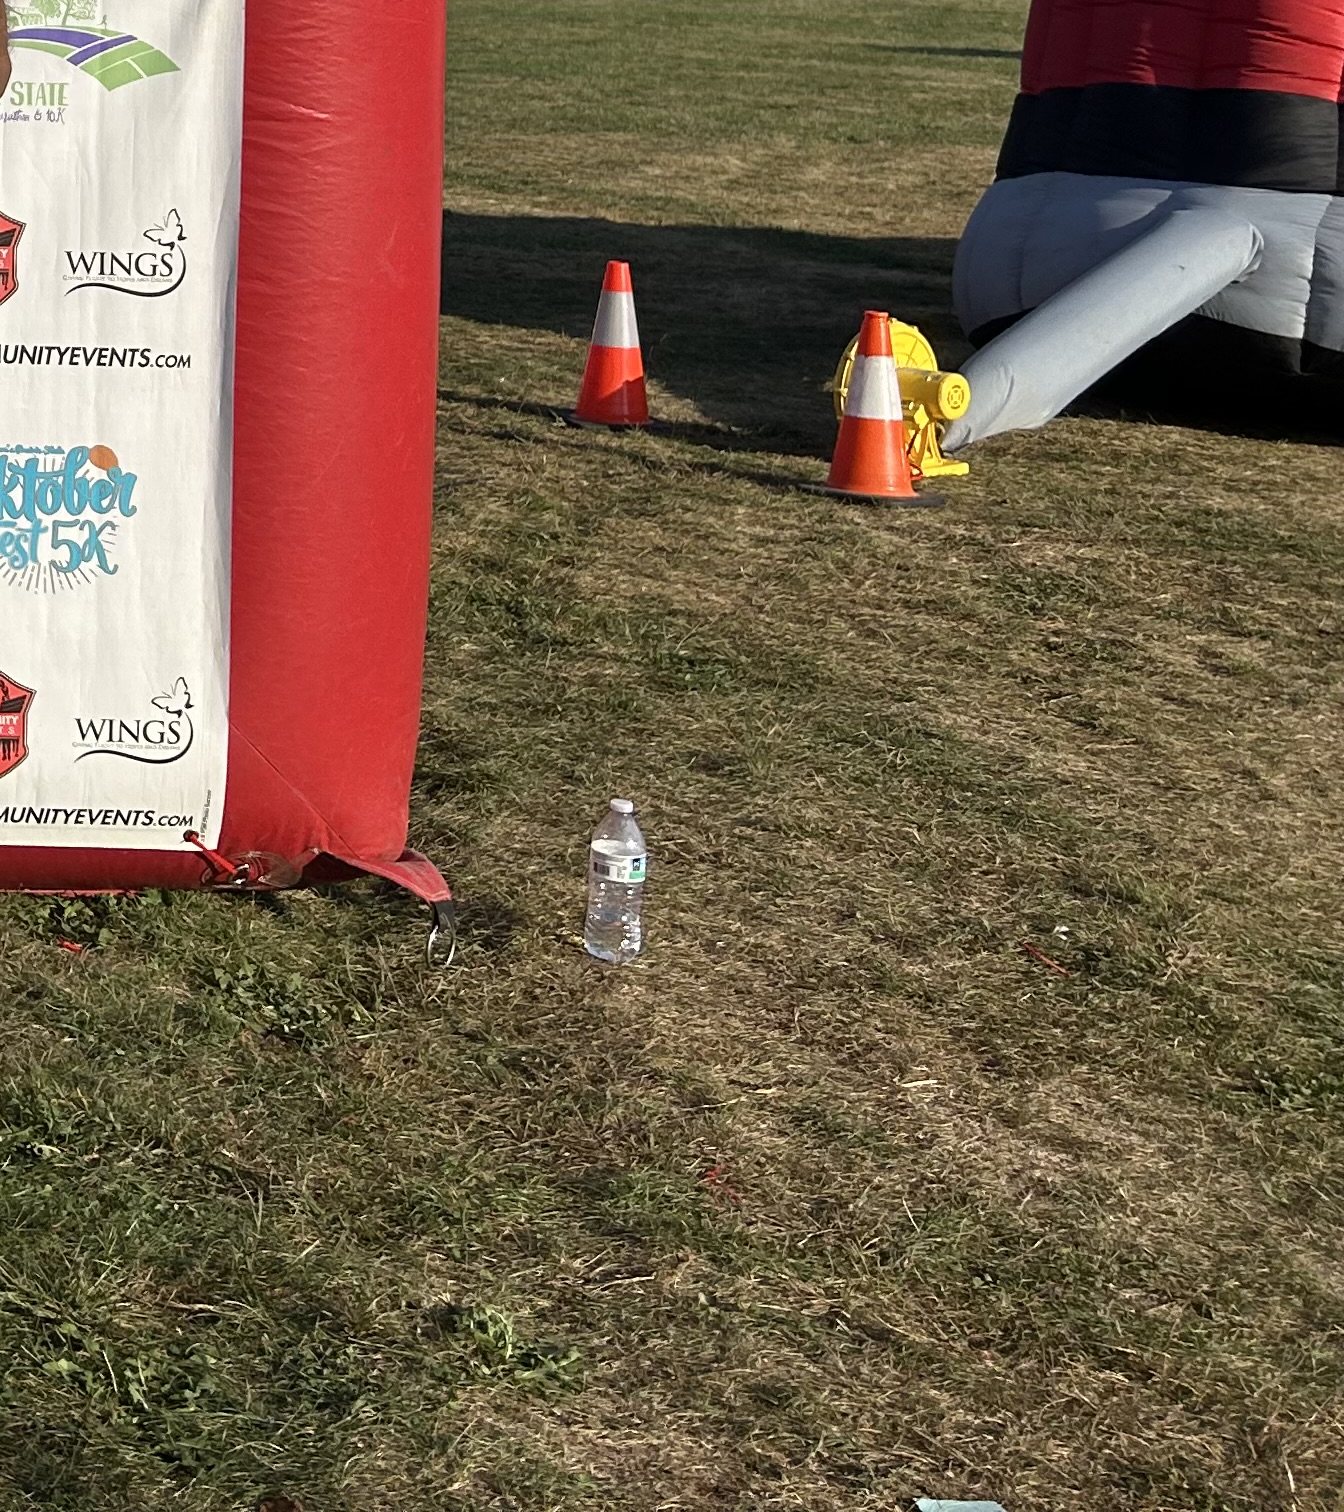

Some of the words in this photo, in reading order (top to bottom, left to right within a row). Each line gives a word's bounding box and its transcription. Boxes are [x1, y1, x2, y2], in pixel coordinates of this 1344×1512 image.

[10, 81, 69, 106] STATE
[65, 250, 173, 277] WINGS
[51, 518, 119, 575] 5K
[74, 717, 181, 745] WINGS
